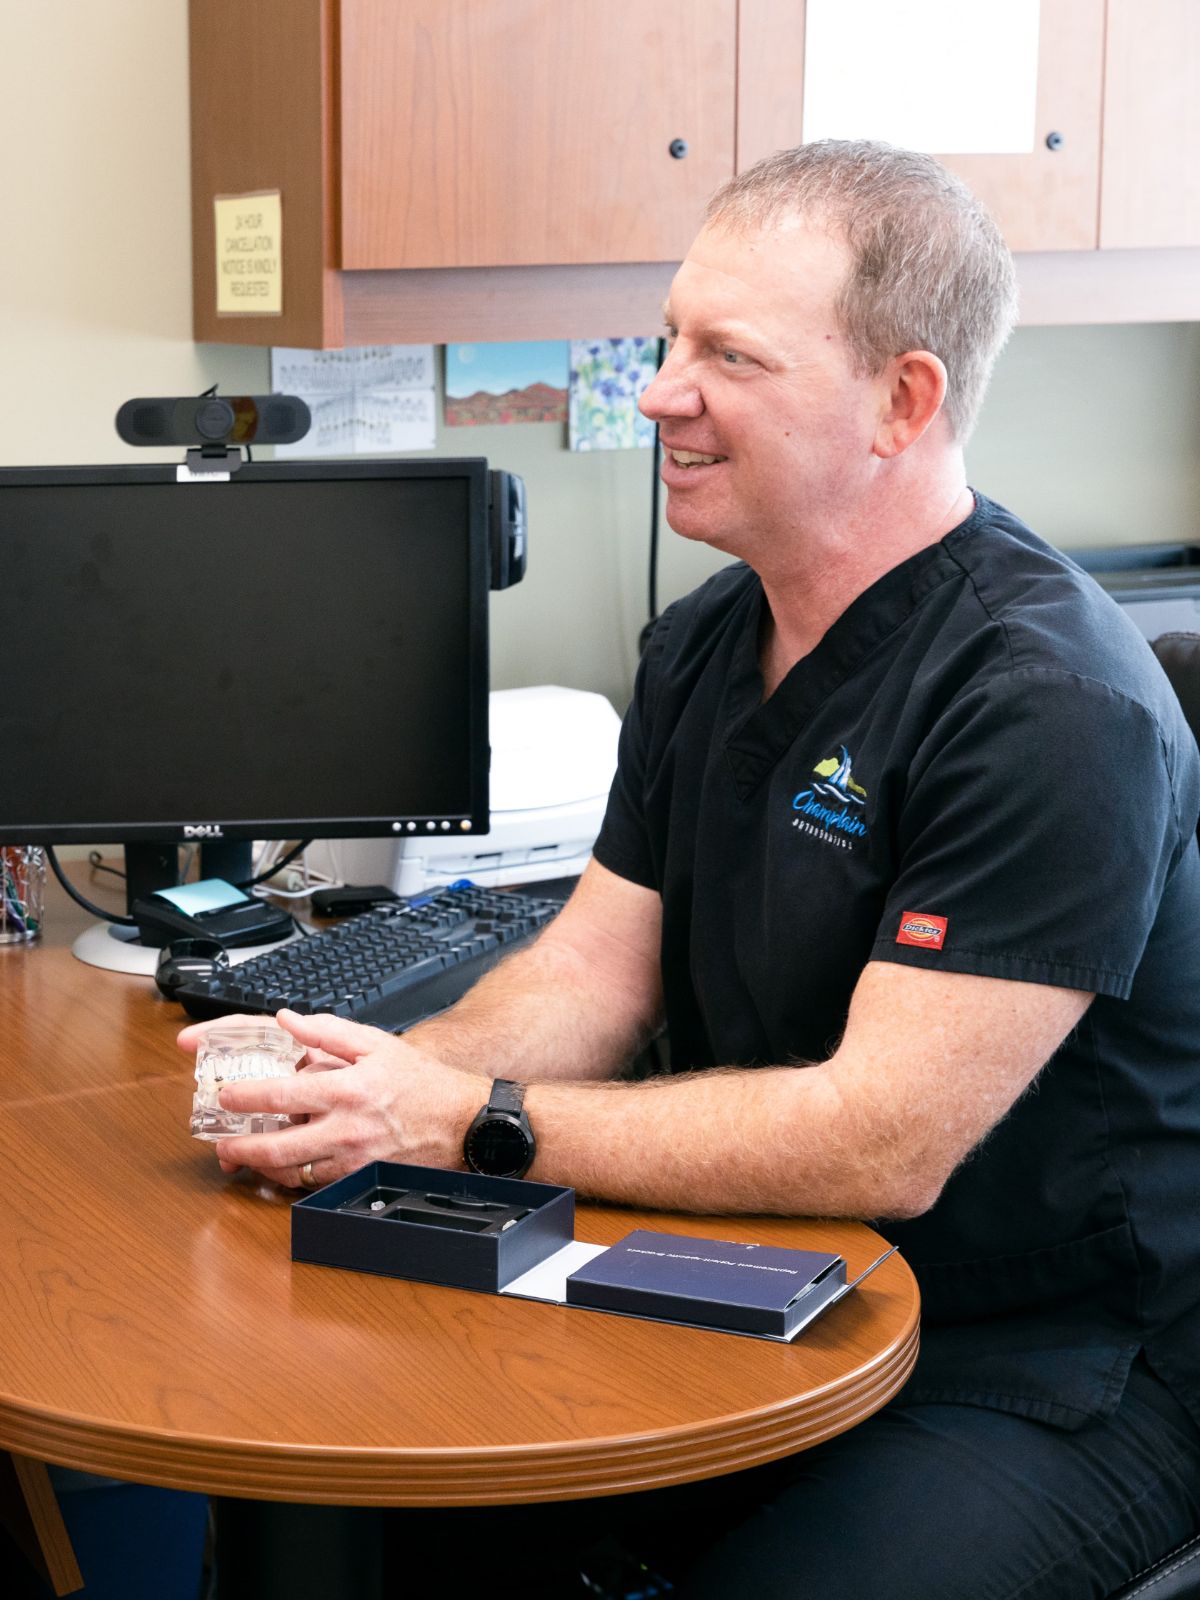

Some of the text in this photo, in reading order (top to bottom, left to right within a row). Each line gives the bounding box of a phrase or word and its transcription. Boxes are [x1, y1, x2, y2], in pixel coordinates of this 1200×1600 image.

[245, 213, 263, 229] HOUR
[225, 236, 273, 252] CANCELLATION
[222, 258, 245, 275] NOTICE
[255, 257, 276, 274] KINDLY
[230, 281, 269, 296] REQUESTED
[792, 790, 868, 836] Champlain
[184, 825, 224, 838] DELL
[905, 924, 939, 935] Dickies
